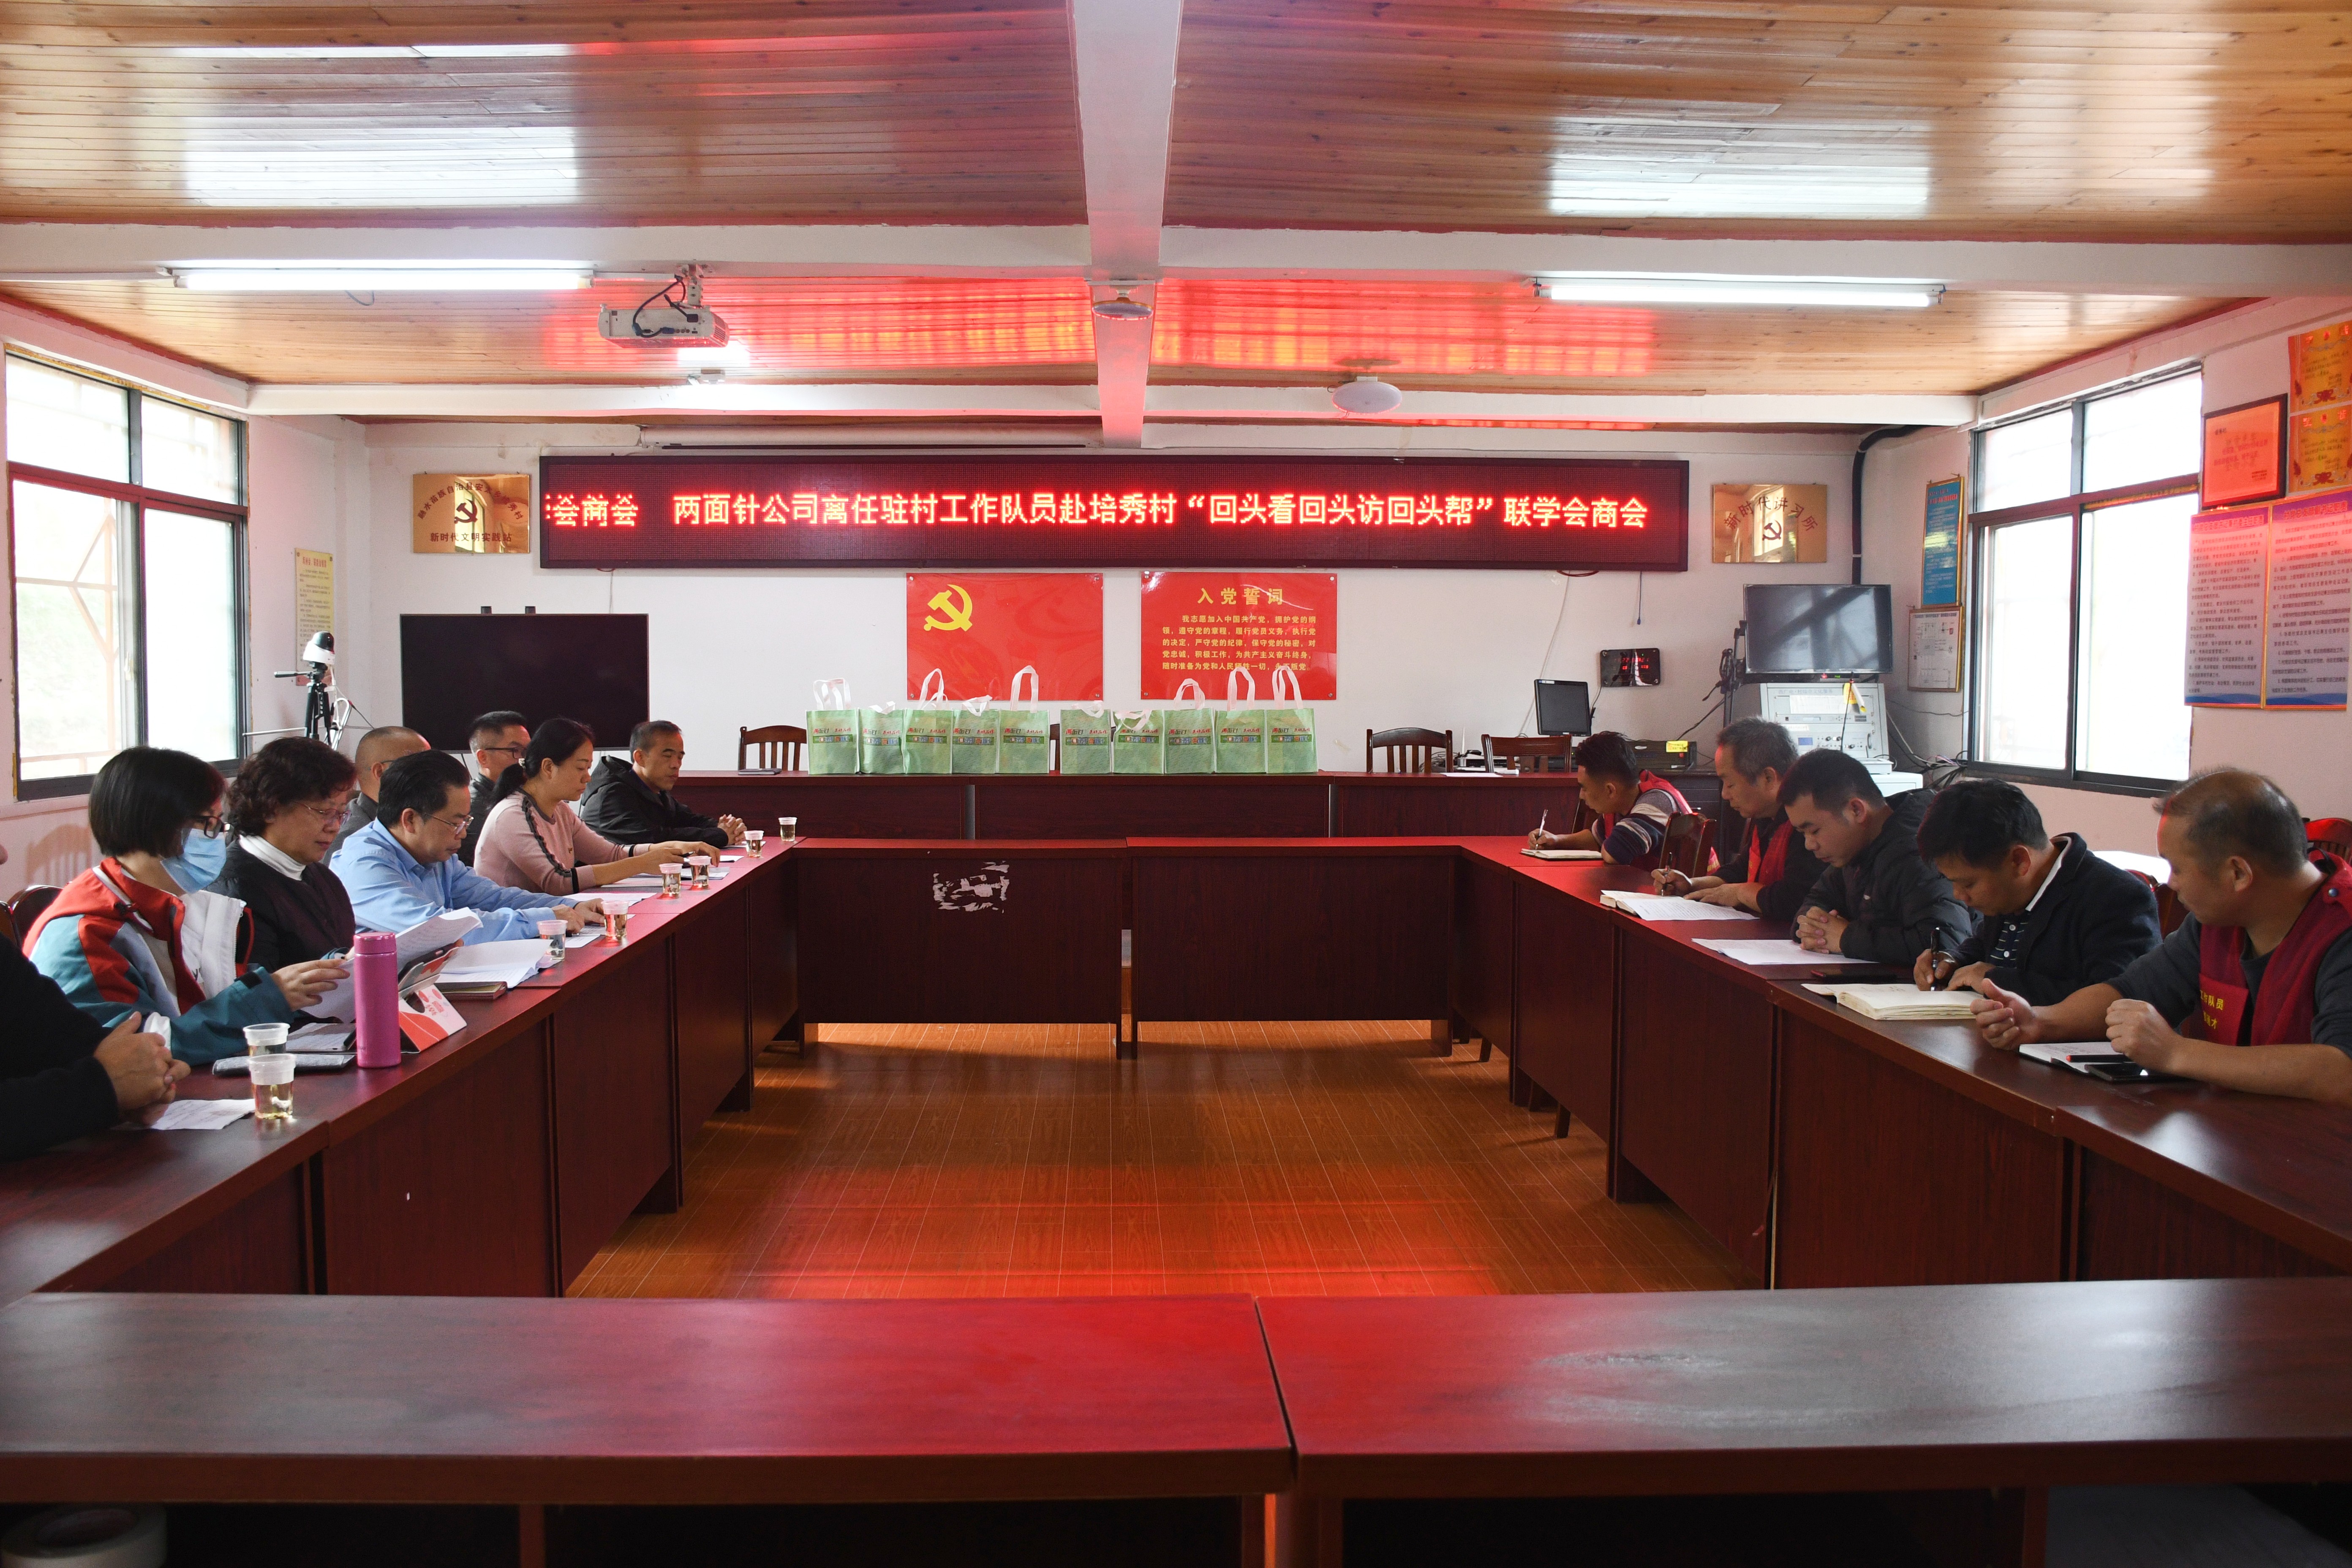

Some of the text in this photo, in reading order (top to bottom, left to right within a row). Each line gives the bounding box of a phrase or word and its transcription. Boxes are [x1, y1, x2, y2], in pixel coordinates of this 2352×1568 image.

[1724, 496, 1818, 531] 新时代讲习所
[430, 533, 512, 542] 新时代文明实践站
[1198, 588, 1283, 605] 入党誓词
[1182, 615, 1316, 624] 我志愿加入中国共产党，拥护党的纲
[1162, 627, 1316, 636] 领，遵守党的章程，履行党员义务，执行党
[1162, 639, 1316, 647] 的决定，严守党的纪律，保守党的秘密，对
[1162, 651, 1312, 659] 党忠诚，积极工作，为共产主义奋斗终身，
